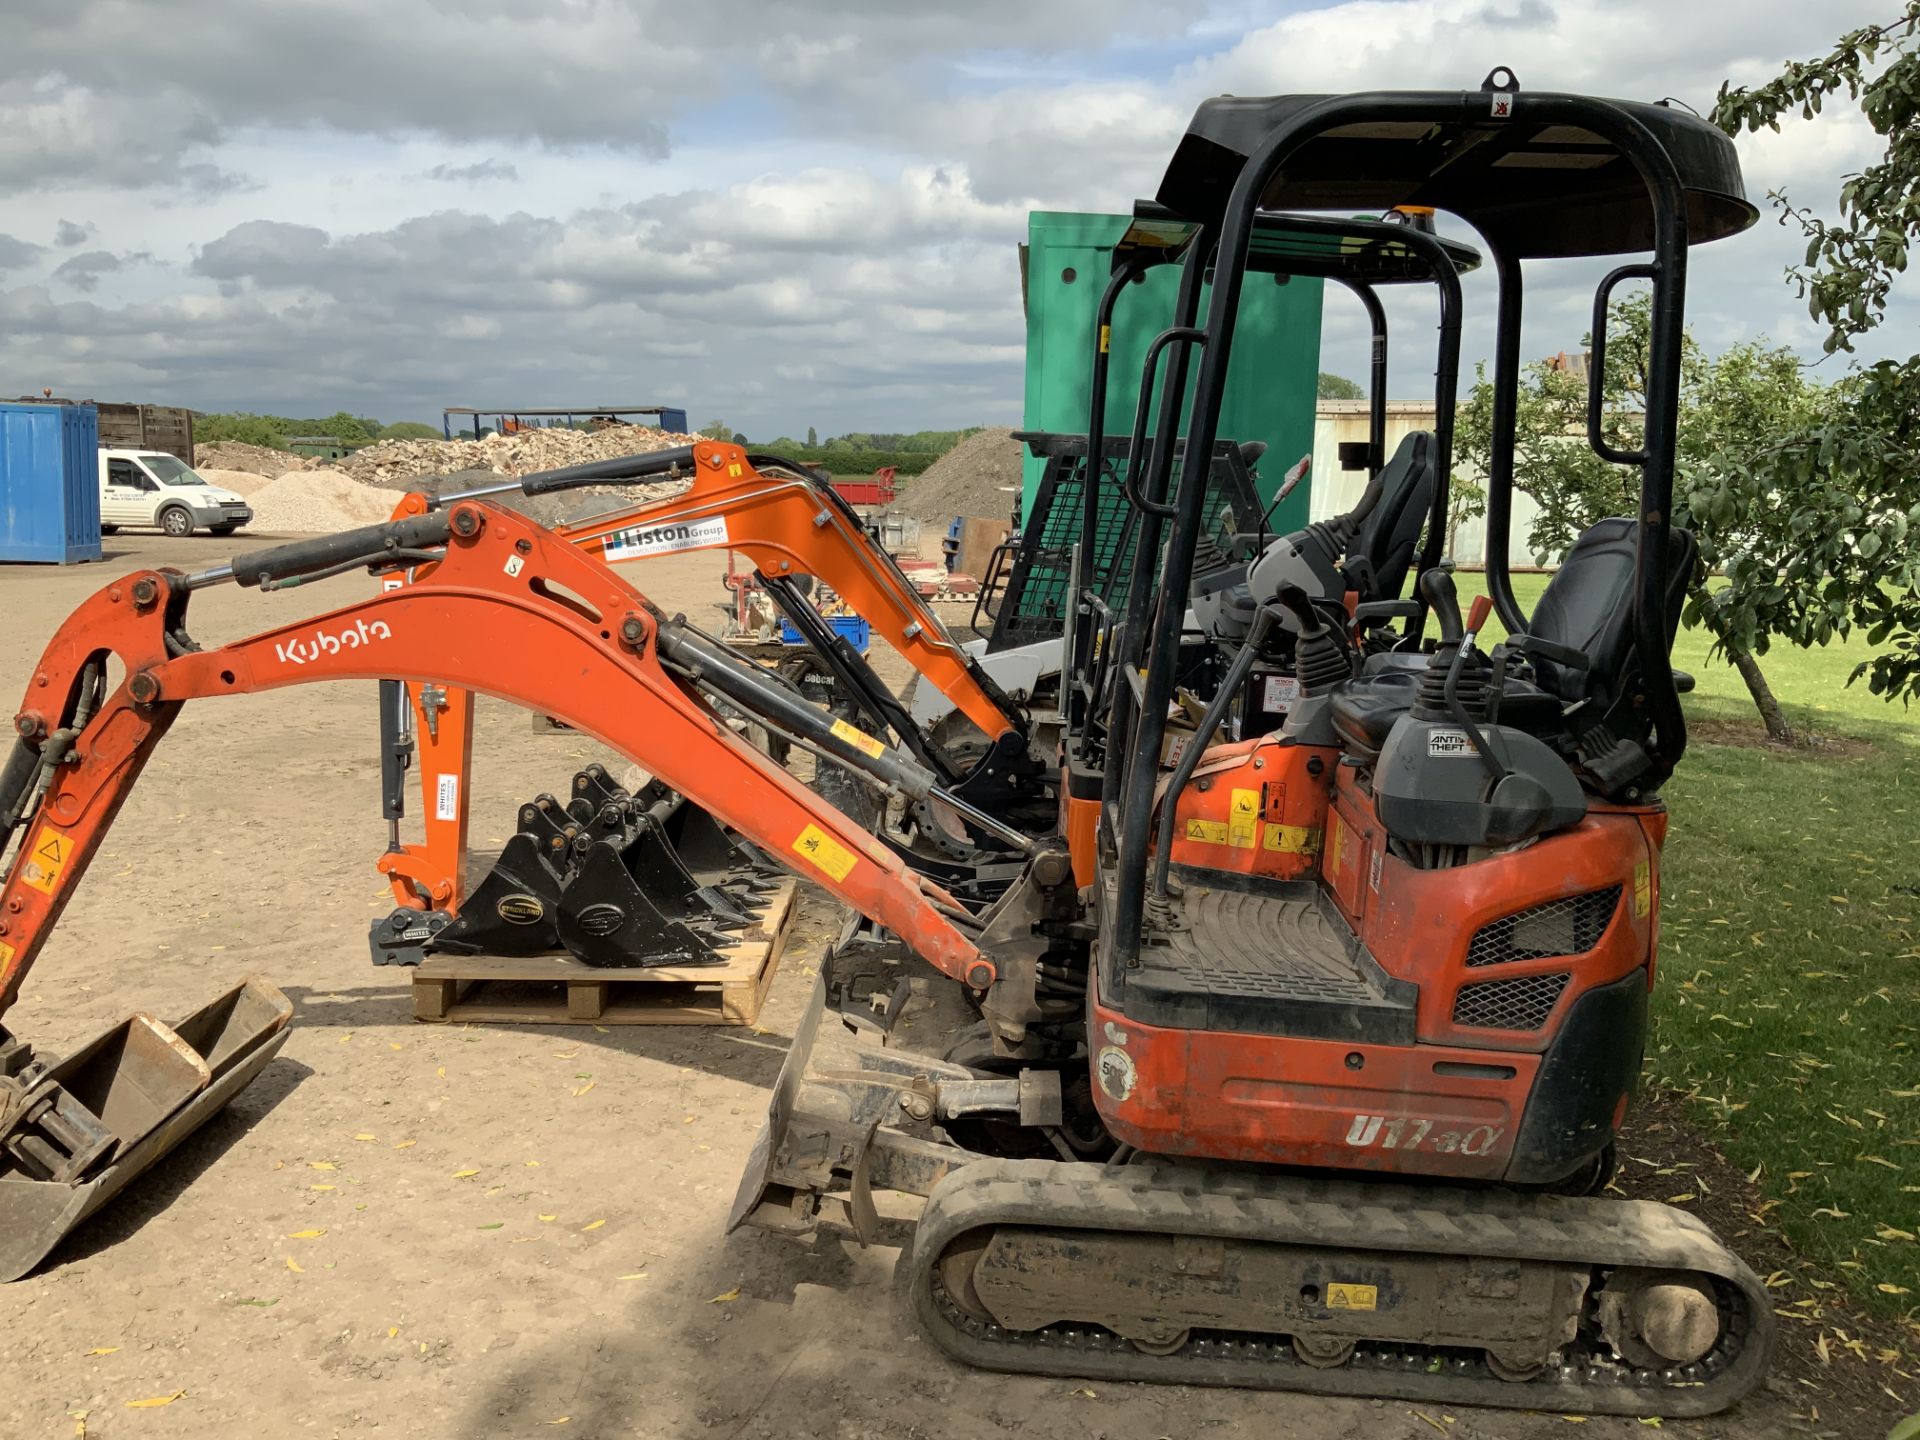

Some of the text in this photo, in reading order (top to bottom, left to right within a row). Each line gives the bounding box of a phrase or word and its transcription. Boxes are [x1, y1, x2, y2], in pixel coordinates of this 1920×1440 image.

[624, 526, 724, 547] Liston Group
[275, 618, 392, 665] Kubota
[804, 673, 834, 685] Bobcat
[440, 783, 448, 811] WHITES
